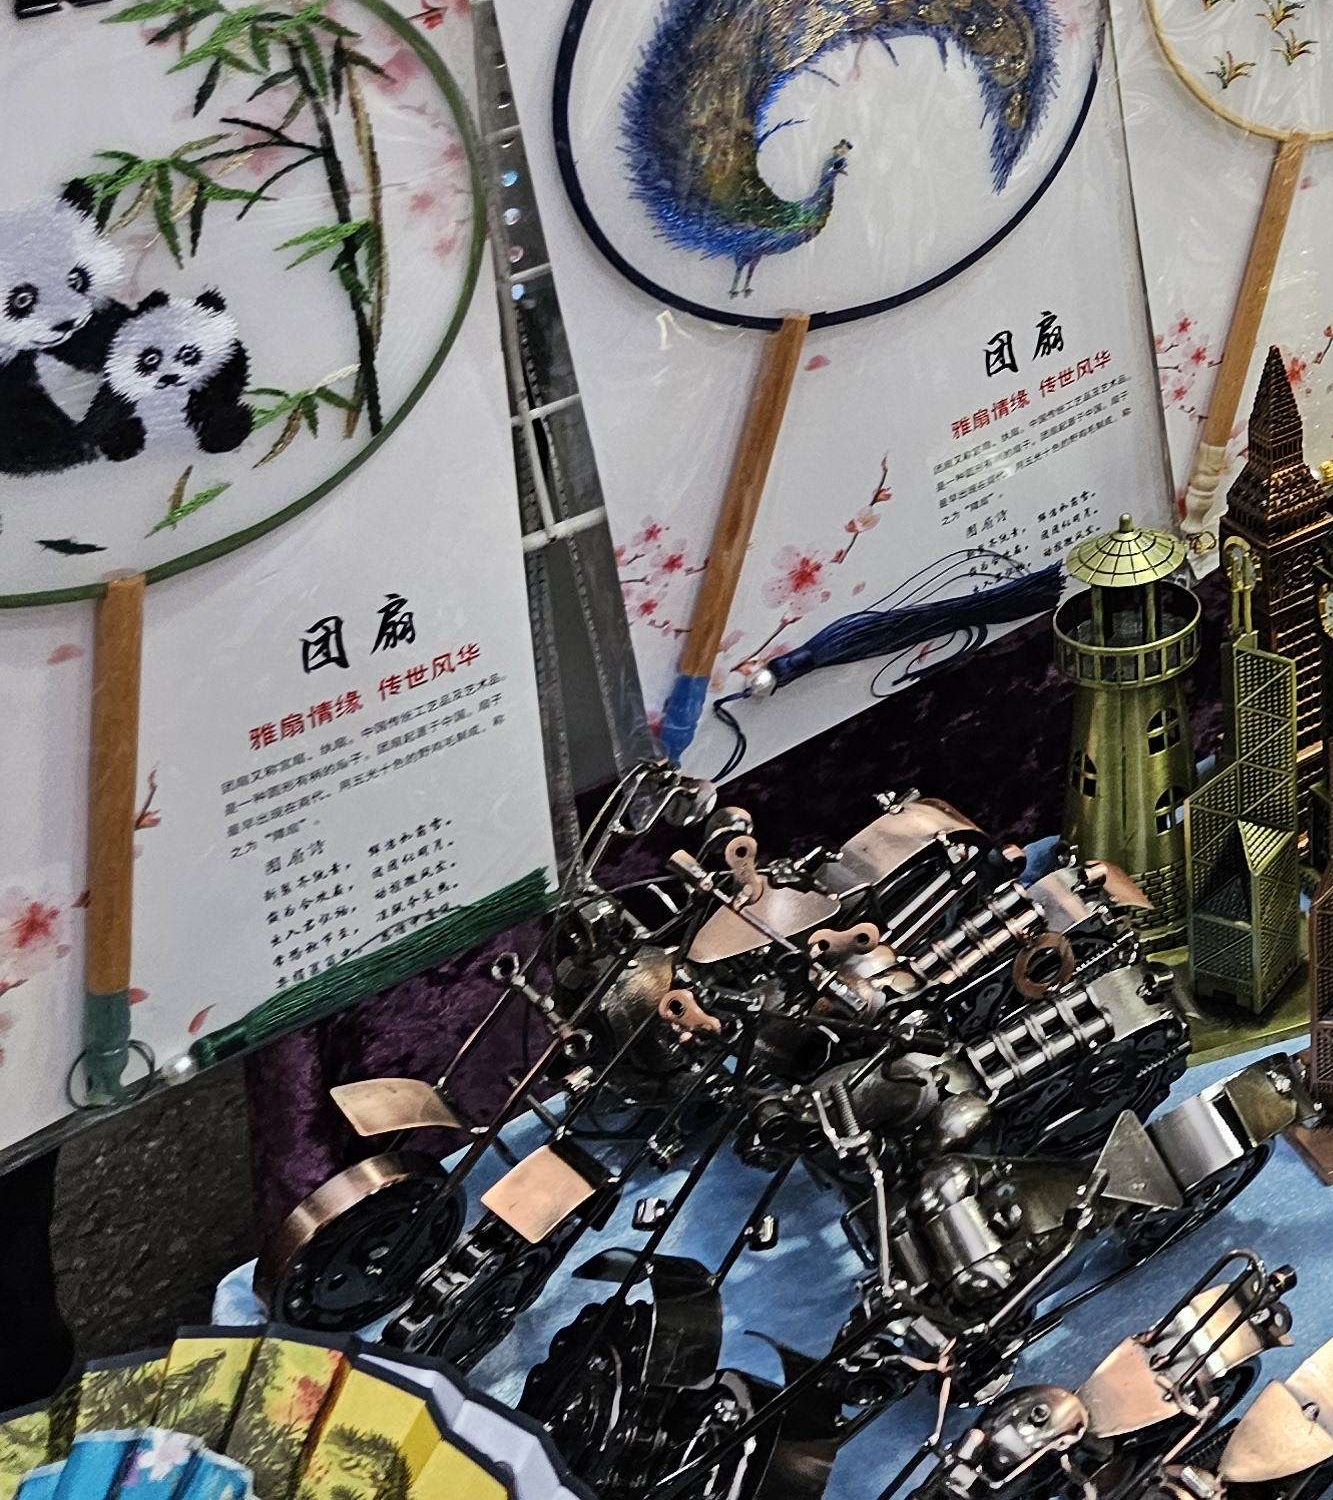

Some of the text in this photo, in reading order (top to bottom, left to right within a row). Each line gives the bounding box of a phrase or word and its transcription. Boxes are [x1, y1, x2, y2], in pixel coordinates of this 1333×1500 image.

[983, 310, 1064, 377] 团扇
[951, 350, 1112, 440] 雅扇情缘 传世风华
[299, 593, 417, 674] 团扇
[248, 642, 481, 750] 雅扇情缘 传世风华
